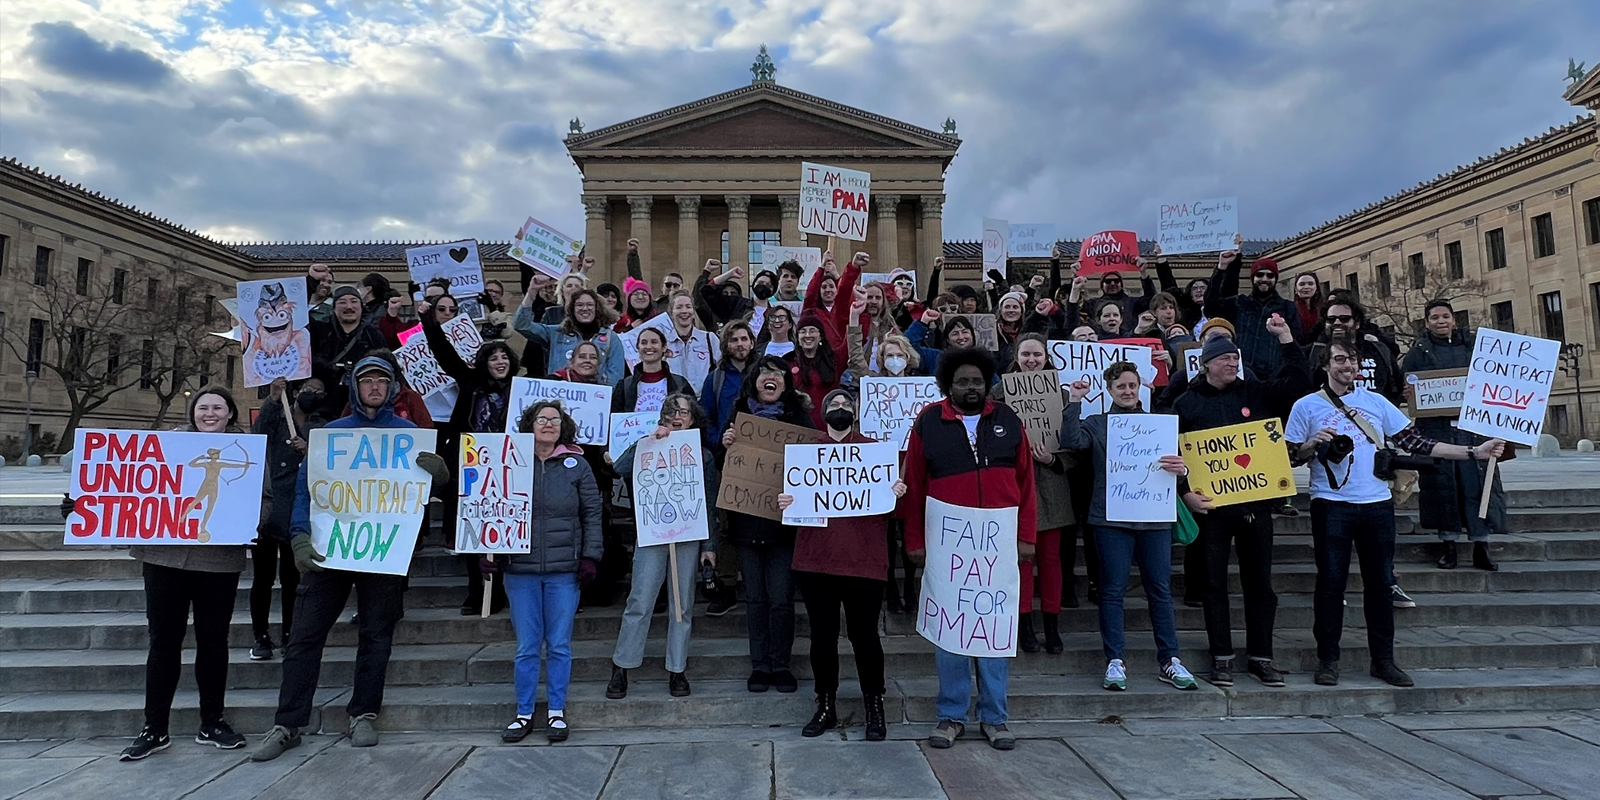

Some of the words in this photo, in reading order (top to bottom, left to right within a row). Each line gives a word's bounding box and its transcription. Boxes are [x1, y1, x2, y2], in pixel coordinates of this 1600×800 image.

[807, 168, 820, 184] I
[823, 171, 841, 187] AM
[848, 177, 871, 188] PROUD
[802, 186, 831, 197] MEMBER
[832, 188, 868, 212] PMA
[1222, 201, 1232, 212] to
[534, 227, 550, 238] LET
[801, 206, 865, 237] UNION
[1160, 220, 1196, 232] Enforcing
[1202, 215, 1222, 226] Your
[524, 233, 548, 250] UNION
[1086, 242, 1121, 258] UNION
[1090, 232, 1116, 246] PMA
[1187, 240, 1222, 250] contract
[412, 253, 440, 268] ART
[526, 246, 538, 257] BE
[1094, 253, 1136, 266] STRONG
[1480, 336, 1538, 361] FAIR
[266, 365, 288, 375] UNION
[1472, 356, 1553, 385] CONTRACT
[413, 372, 450, 396] UNION
[525, 380, 588, 402] Museum
[1004, 372, 1057, 396] UNION
[1482, 382, 1535, 406] NOW
[864, 400, 896, 418] ART
[1011, 398, 1046, 414] STARTS
[1420, 392, 1444, 406] FAIR
[624, 418, 640, 428] Ask
[880, 418, 904, 430] NOT
[1110, 416, 1129, 429] Put
[1464, 406, 1492, 425] PMA
[1496, 412, 1541, 436] UNION
[84, 432, 165, 462] PMA
[864, 431, 892, 442] THE
[1196, 434, 1238, 456] HONK
[1243, 433, 1256, 448] IF
[327, 433, 414, 470] FAIR
[502, 434, 528, 468] A
[817, 446, 862, 464] FAIR
[1116, 442, 1162, 457] Monet
[728, 450, 748, 468] FOR
[755, 458, 765, 473] A
[1109, 459, 1138, 474] Where
[1204, 458, 1229, 473] YOU
[79, 464, 184, 494] UNION
[459, 465, 528, 502] PAL
[637, 464, 698, 487] CONT
[787, 464, 894, 487] CONTRACT
[1211, 473, 1268, 495] UNIONS
[312, 479, 428, 514] CONTRACT
[638, 481, 700, 506] RACT
[814, 489, 871, 513] NOW!
[1110, 482, 1150, 502] Mouth
[71, 494, 203, 540] STRONG
[642, 498, 704, 526] NOW
[326, 518, 400, 562] NOW
[457, 518, 530, 550] NOW!!
[941, 516, 1000, 552] FAIR
[950, 553, 998, 586] PAY
[958, 588, 1008, 616] FOR
[922, 597, 1013, 651] PMAU
